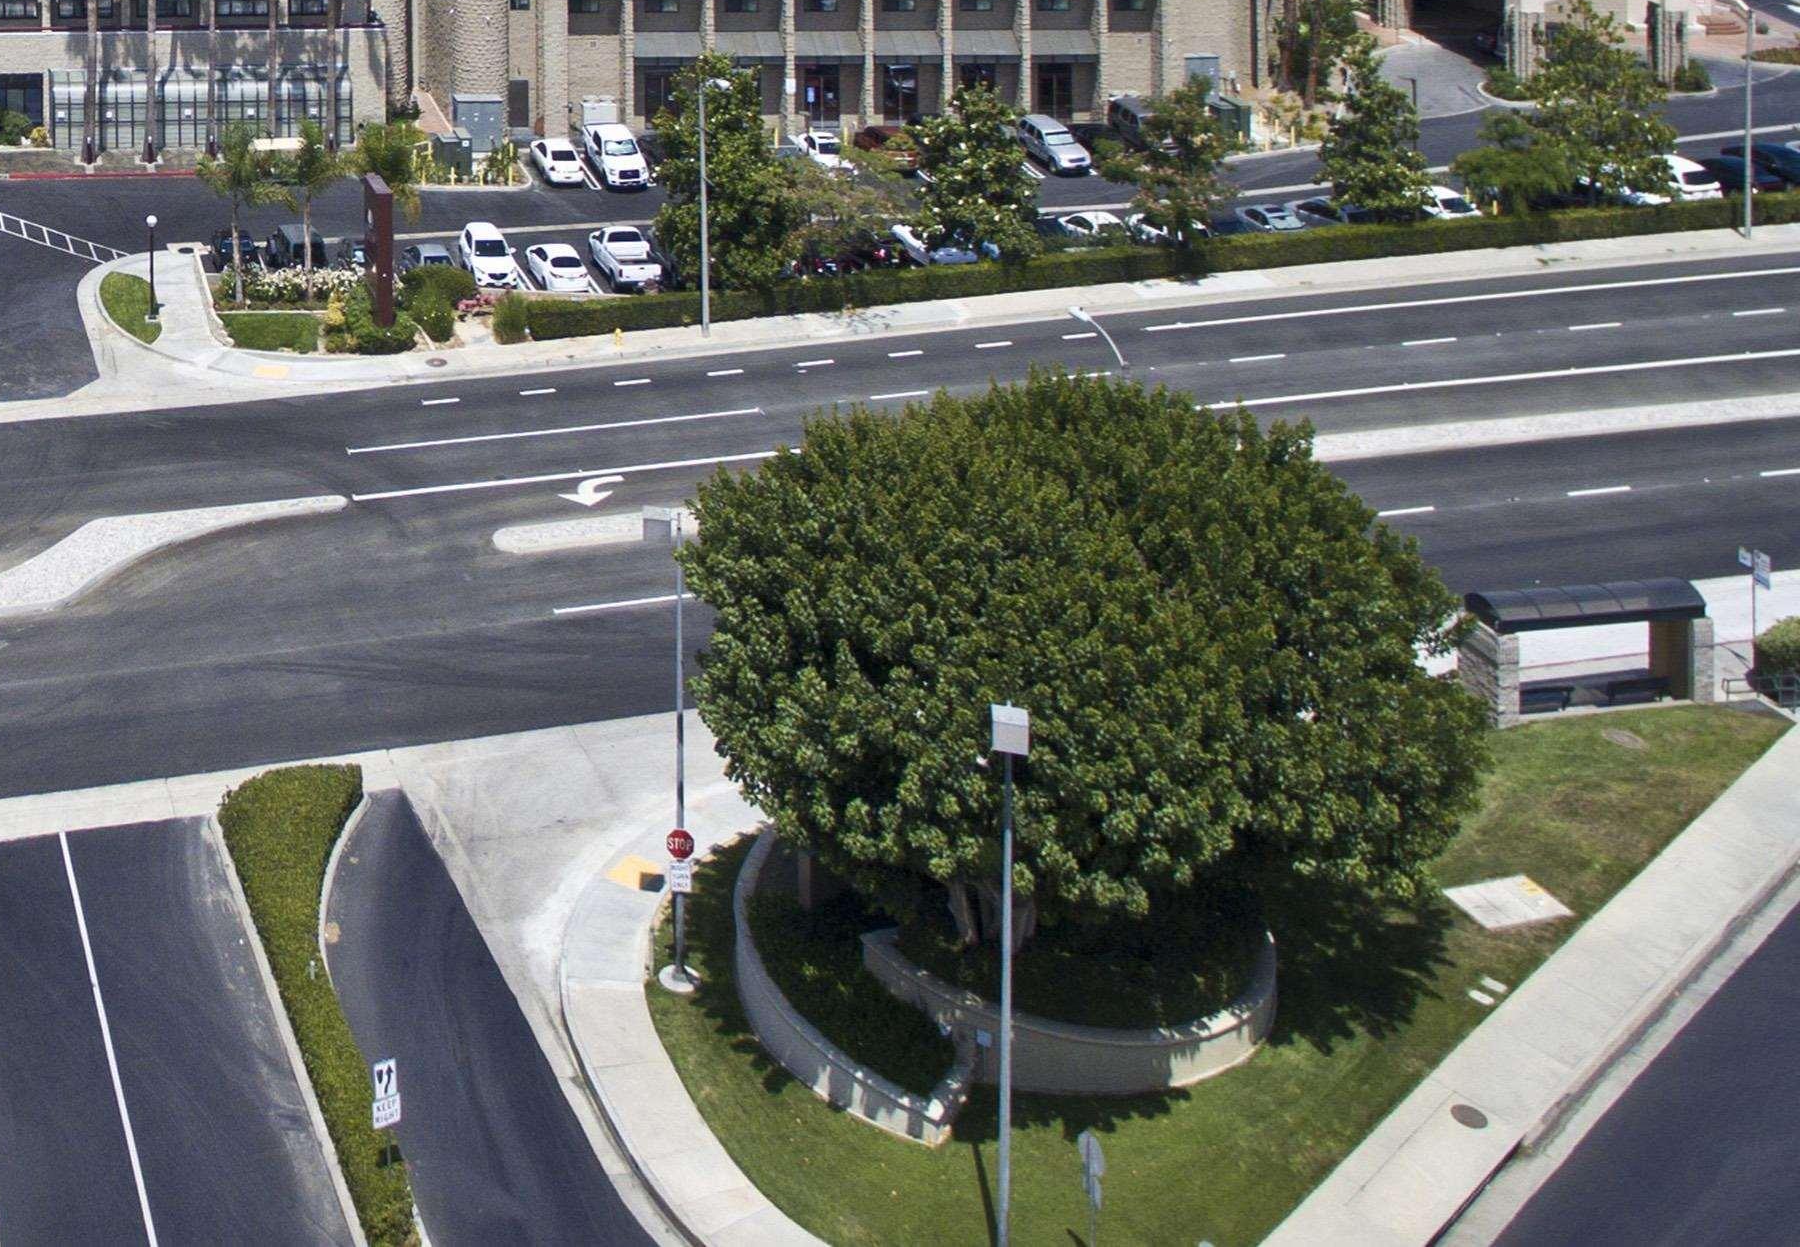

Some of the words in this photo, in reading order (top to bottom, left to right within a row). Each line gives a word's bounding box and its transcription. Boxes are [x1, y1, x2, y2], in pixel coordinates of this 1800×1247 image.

[668, 837, 693, 850] STOP
[376, 1099, 397, 1112] KEEP
[375, 1108, 398, 1123] RIGHT
